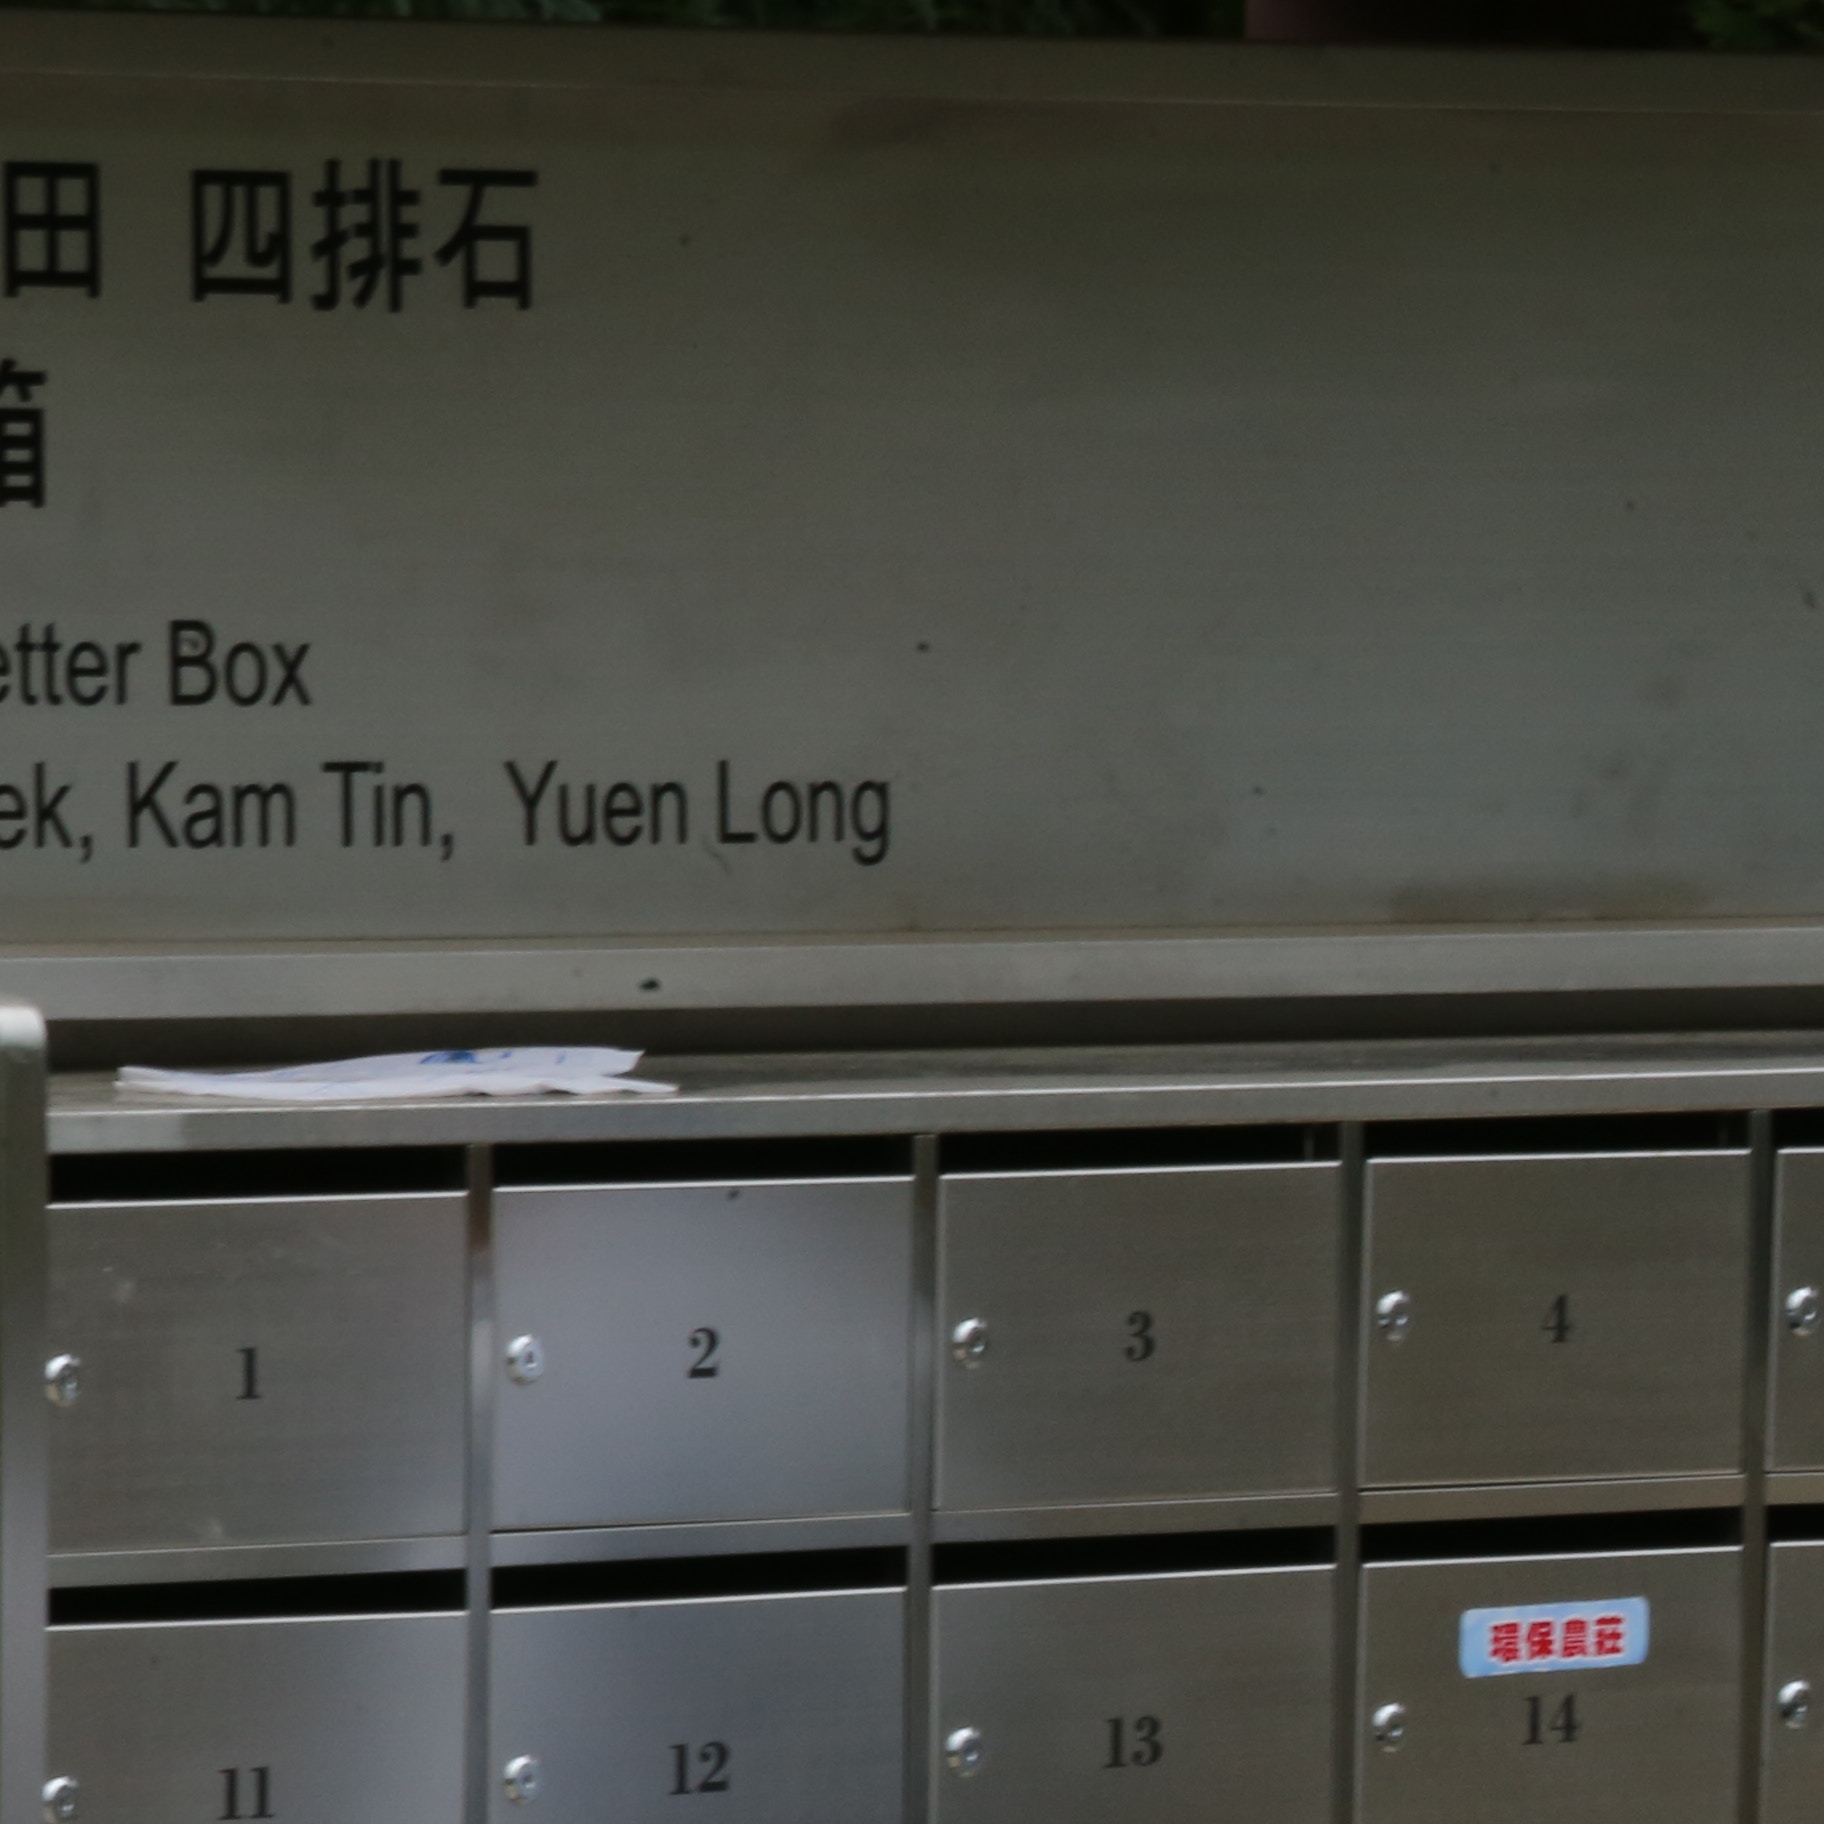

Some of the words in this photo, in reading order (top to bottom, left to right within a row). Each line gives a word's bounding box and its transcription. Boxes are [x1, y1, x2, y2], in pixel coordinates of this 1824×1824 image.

[3, 160, 99, 298] 田
[191, 158, 538, 313] 四排石
[0, 621, 142, 707] tter
[168, 619, 313, 707] Box
[126, 760, 297, 849] Kam
[320, 760, 455, 862] Tin,
[503, 759, 689, 847] Yuen
[716, 759, 892, 868] Long
[1124, 1311, 1156, 1362] 3
[1542, 1294, 1573, 1343] 4
[237, 1347, 260, 1400] 1
[688, 1327, 719, 1379] 2
[1105, 1715, 1163, 1768] 13
[1523, 1693, 1580, 1745] 14
[219, 1766, 274, 1820] 11
[670, 1741, 730, 1795] 12
